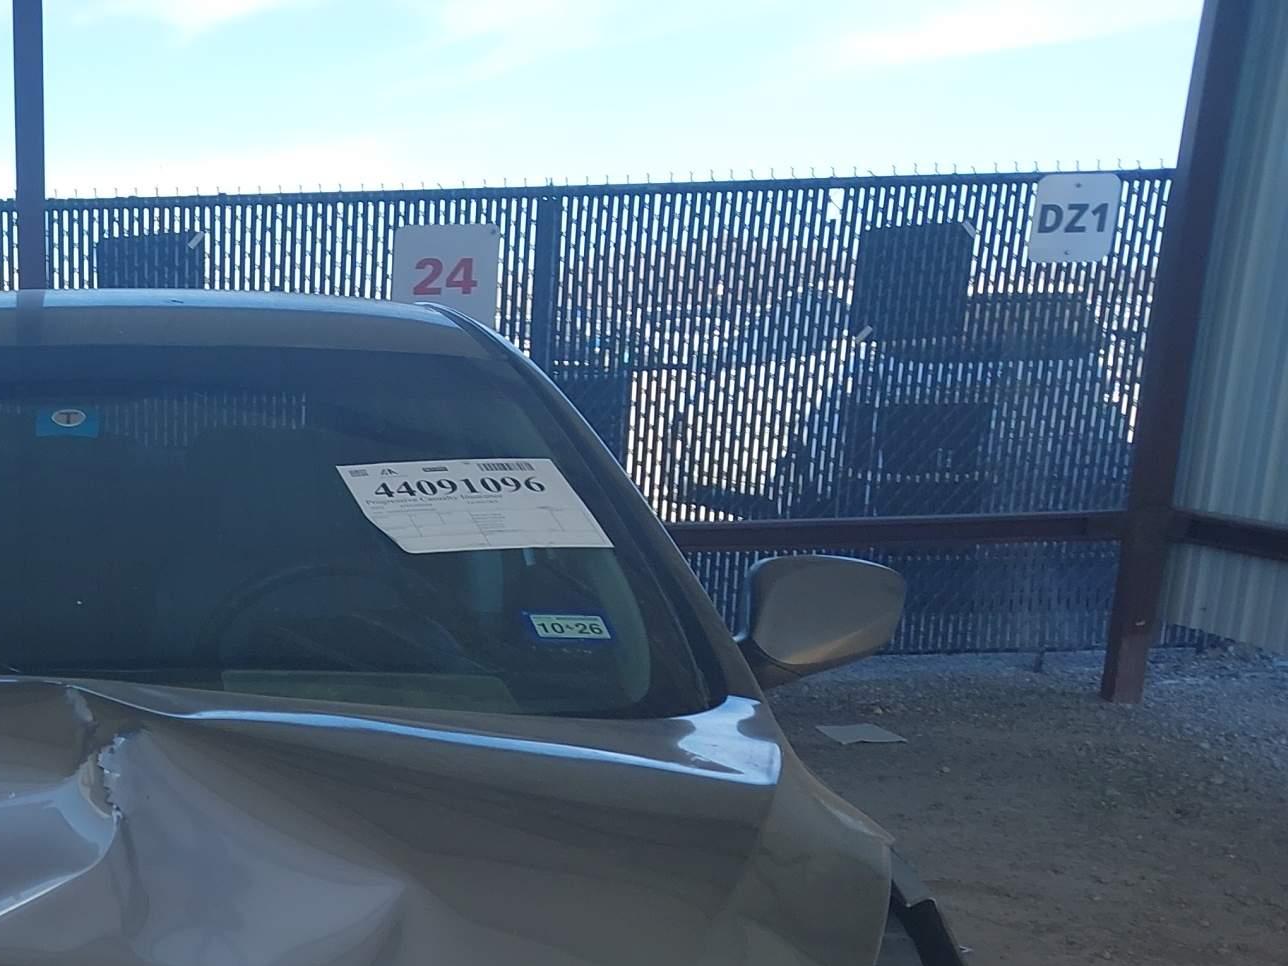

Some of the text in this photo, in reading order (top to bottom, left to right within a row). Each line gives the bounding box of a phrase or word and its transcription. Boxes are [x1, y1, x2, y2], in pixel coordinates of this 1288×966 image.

[1037, 203, 1109, 234] DZ1
[412, 257, 478, 296] 24
[373, 475, 547, 500] 44091096
